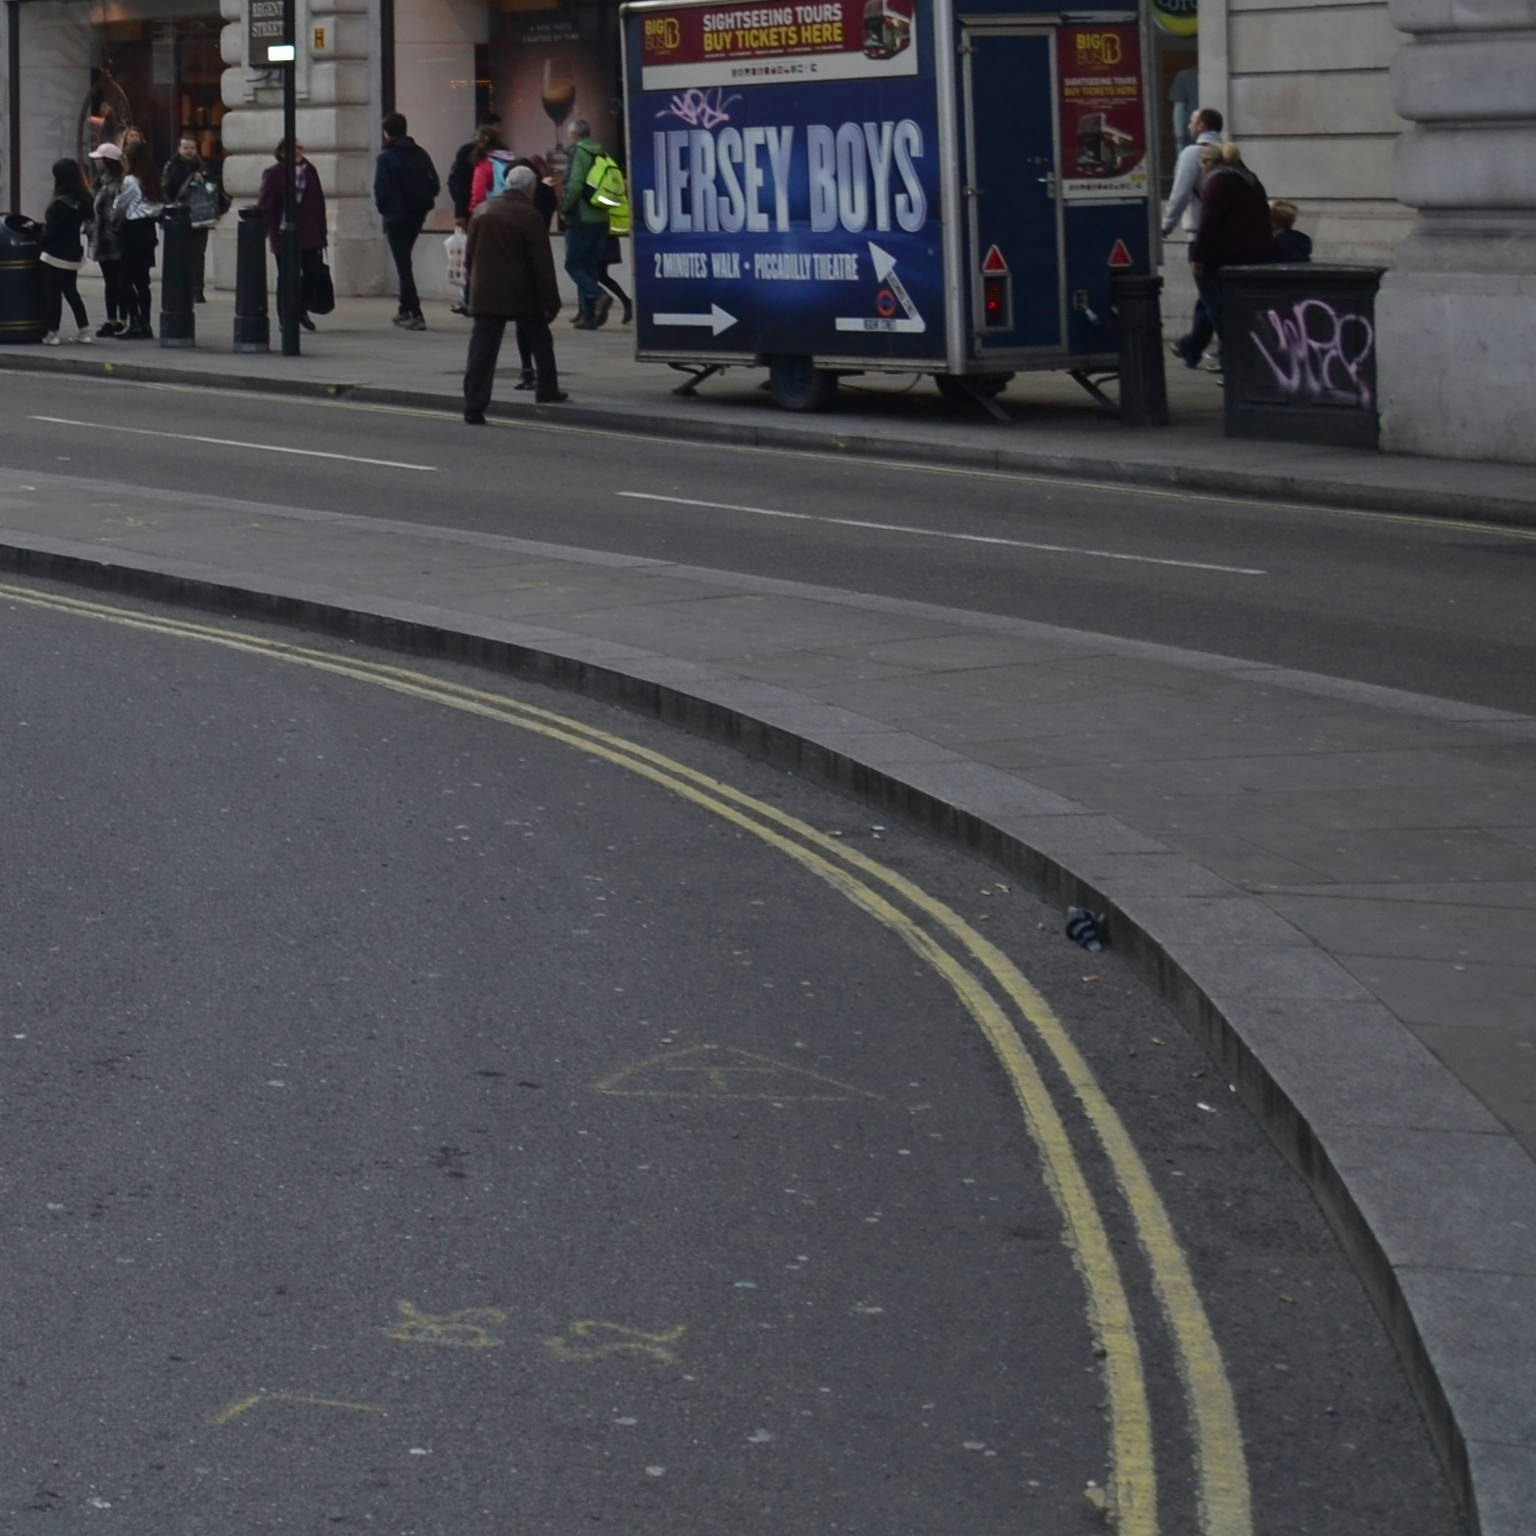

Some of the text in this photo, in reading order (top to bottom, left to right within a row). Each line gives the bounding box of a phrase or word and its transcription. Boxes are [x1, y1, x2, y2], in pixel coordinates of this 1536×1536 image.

[644, 19, 664, 36] BIG
[703, 4, 842, 31] SIGHTSEEING TOURS
[645, 35, 664, 51] BUS
[704, 30, 732, 52] BUY
[736, 25, 798, 49] TICKETS
[801, 21, 844, 44] HERE
[1076, 33, 1101, 49] BIG
[1077, 51, 1101, 65] BUS
[643, 119, 928, 234] JERSEY BOYS
[654, 253, 859, 281] 2 MINUTES WALK PICCADILLY THEATRE
